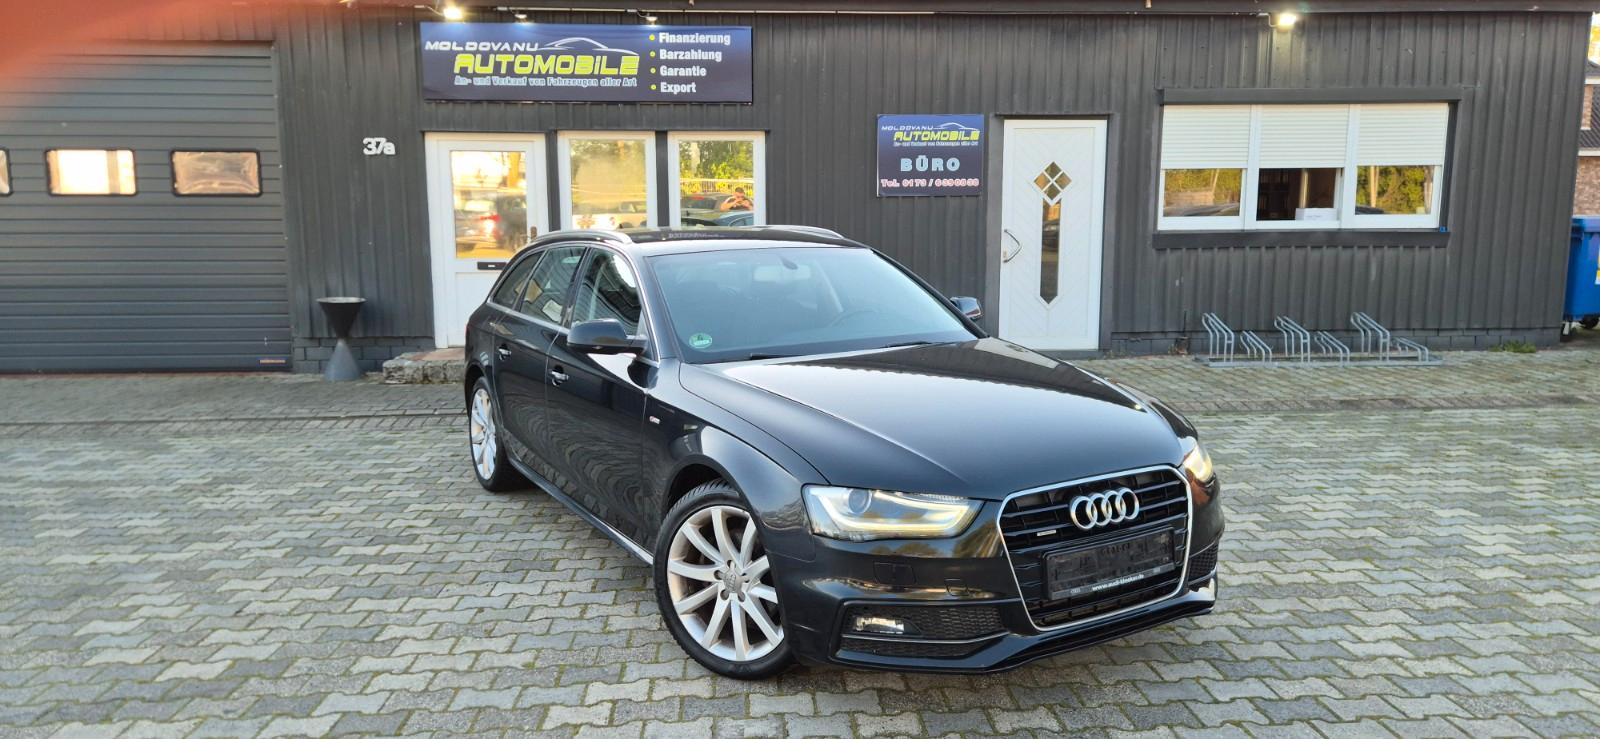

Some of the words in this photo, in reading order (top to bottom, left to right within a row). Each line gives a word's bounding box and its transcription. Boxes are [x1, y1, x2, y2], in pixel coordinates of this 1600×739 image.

[425, 41, 539, 51] MOLDOVANU
[659, 32, 731, 46] Finanzierung
[659, 48, 722, 62] Barzahlung
[453, 53, 640, 75] AUTOMOBILE
[660, 65, 707, 77] Garantie
[473, 76, 491, 86] und
[492, 76, 527, 86] Verkauf
[528, 77, 546, 87] von
[547, 76, 599, 88] Fahrzeugen
[600, 77, 621, 87] aller
[622, 77, 638, 87] Art
[660, 81, 697, 95] Export
[893, 131, 981, 141] AUTOMOBILE
[363, 137, 396, 155] 37a
[900, 155, 960, 172] BÜRO
